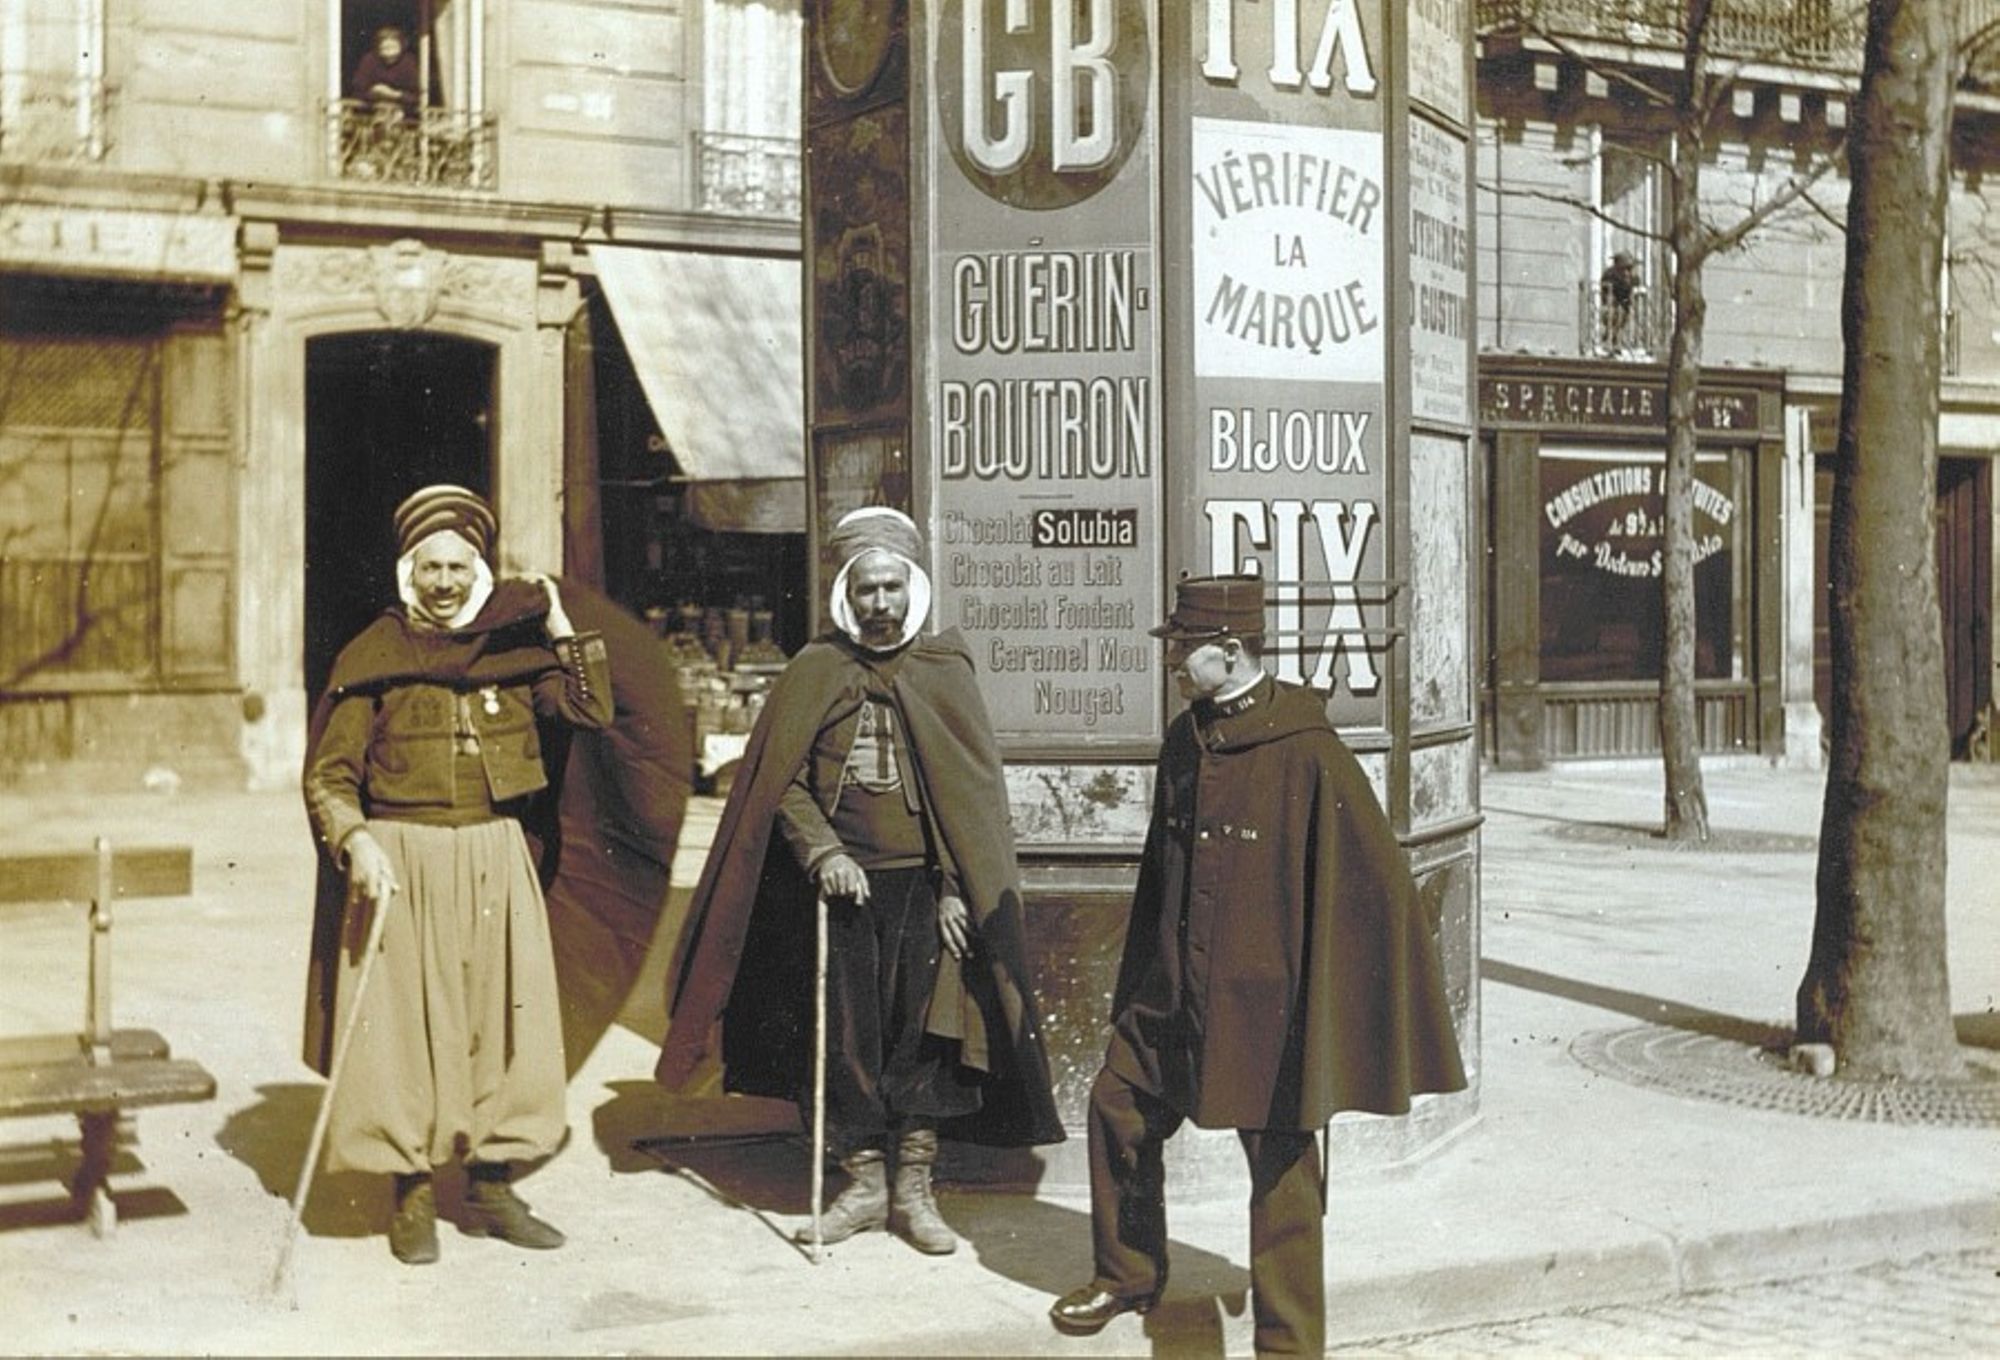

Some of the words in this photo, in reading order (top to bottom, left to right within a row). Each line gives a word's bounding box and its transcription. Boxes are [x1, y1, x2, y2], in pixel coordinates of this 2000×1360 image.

[962, 0, 1122, 175] GB
[1195, 149, 1382, 235] VÉRIFIER
[1273, 233, 1307, 269] LA
[1204, 273, 1378, 356] MARQUE
[1495, 382, 1654, 417] SPECIALE
[940, 376, 1150, 482] BOUTRON
[1209, 407, 1371, 476] BIJOUX
[1545, 466, 1652, 529] CONSULTATIONS
[943, 510, 1033, 546] Chocolat
[1037, 510, 1135, 545] Solubia
[951, 552, 1042, 588] Chocolat
[1049, 561, 1076, 587] au
[1083, 552, 1123, 587] Lait
[961, 594, 1049, 631] Chocolat
[1053, 594, 1135, 631] Fondant
[989, 637, 1089, 673] Caramel
[1099, 637, 1149, 673] Mou
[1033, 678, 1125, 726] Nougat
